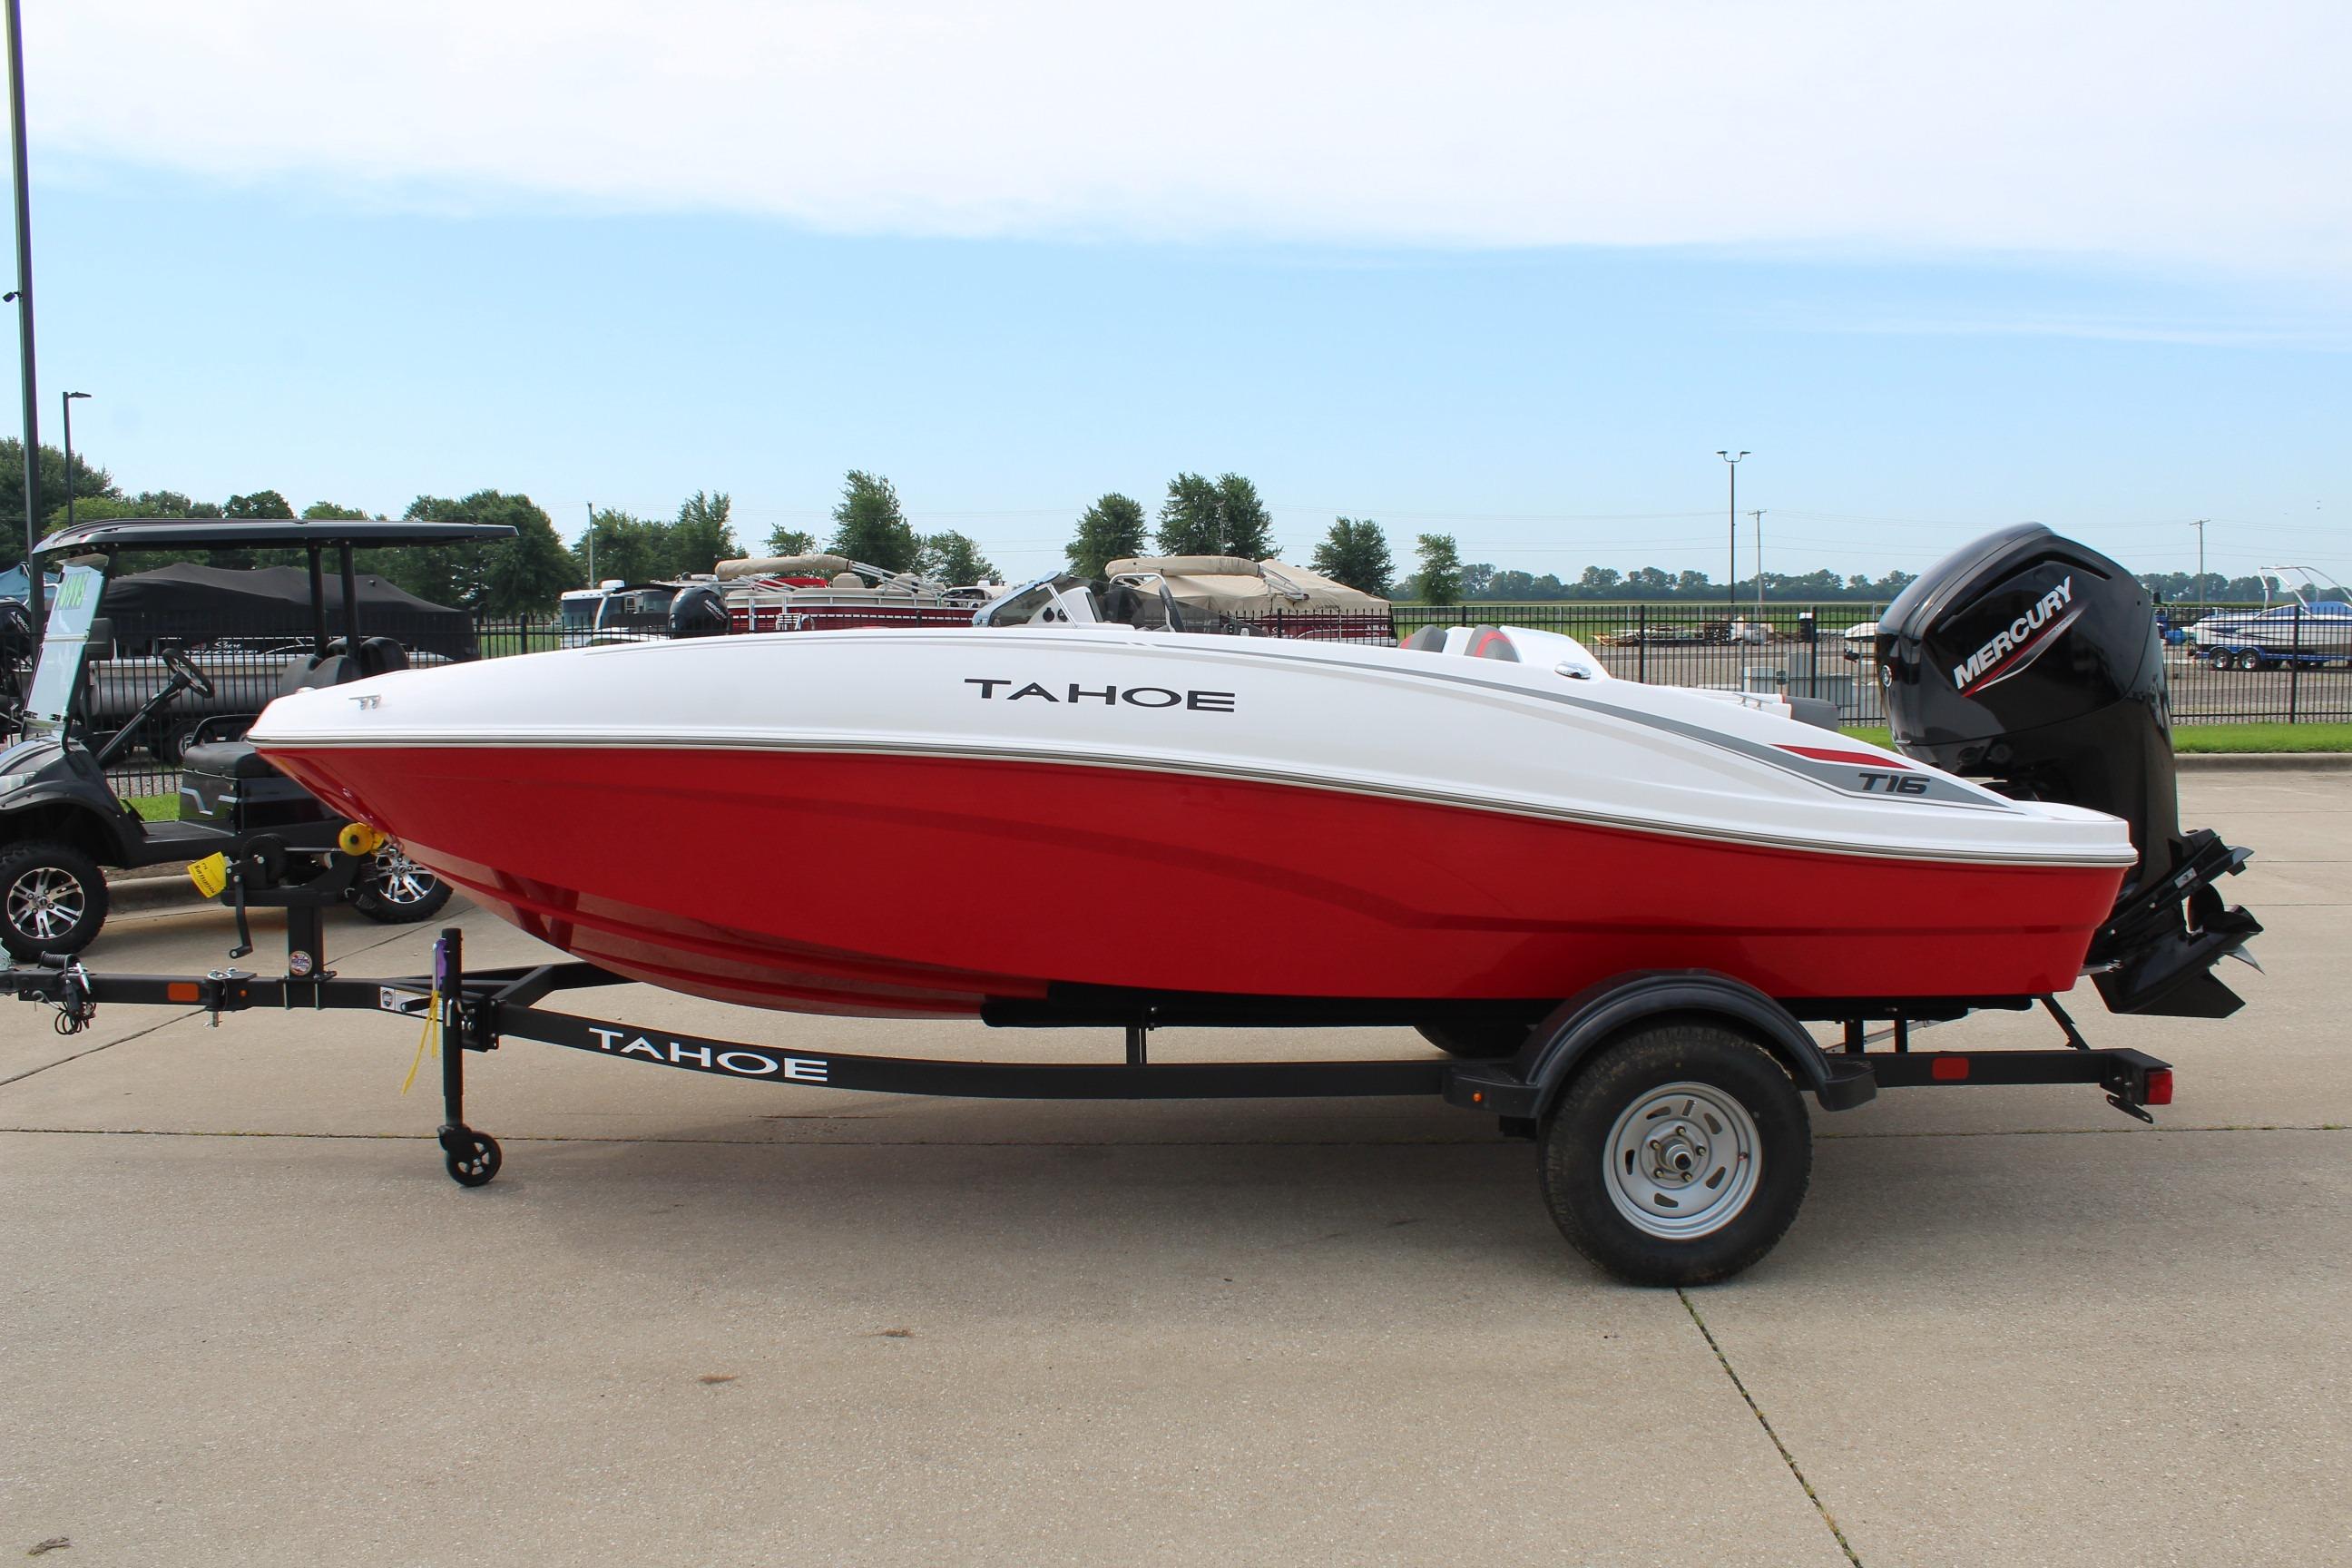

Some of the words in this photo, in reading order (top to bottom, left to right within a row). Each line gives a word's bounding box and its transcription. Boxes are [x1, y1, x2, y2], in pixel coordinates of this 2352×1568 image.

[1954, 575, 2072, 690] MERCURY
[964, 678, 1236, 713] TAHOE
[1858, 772, 1930, 794] T16
[589, 1027, 828, 1081] TAHOE
